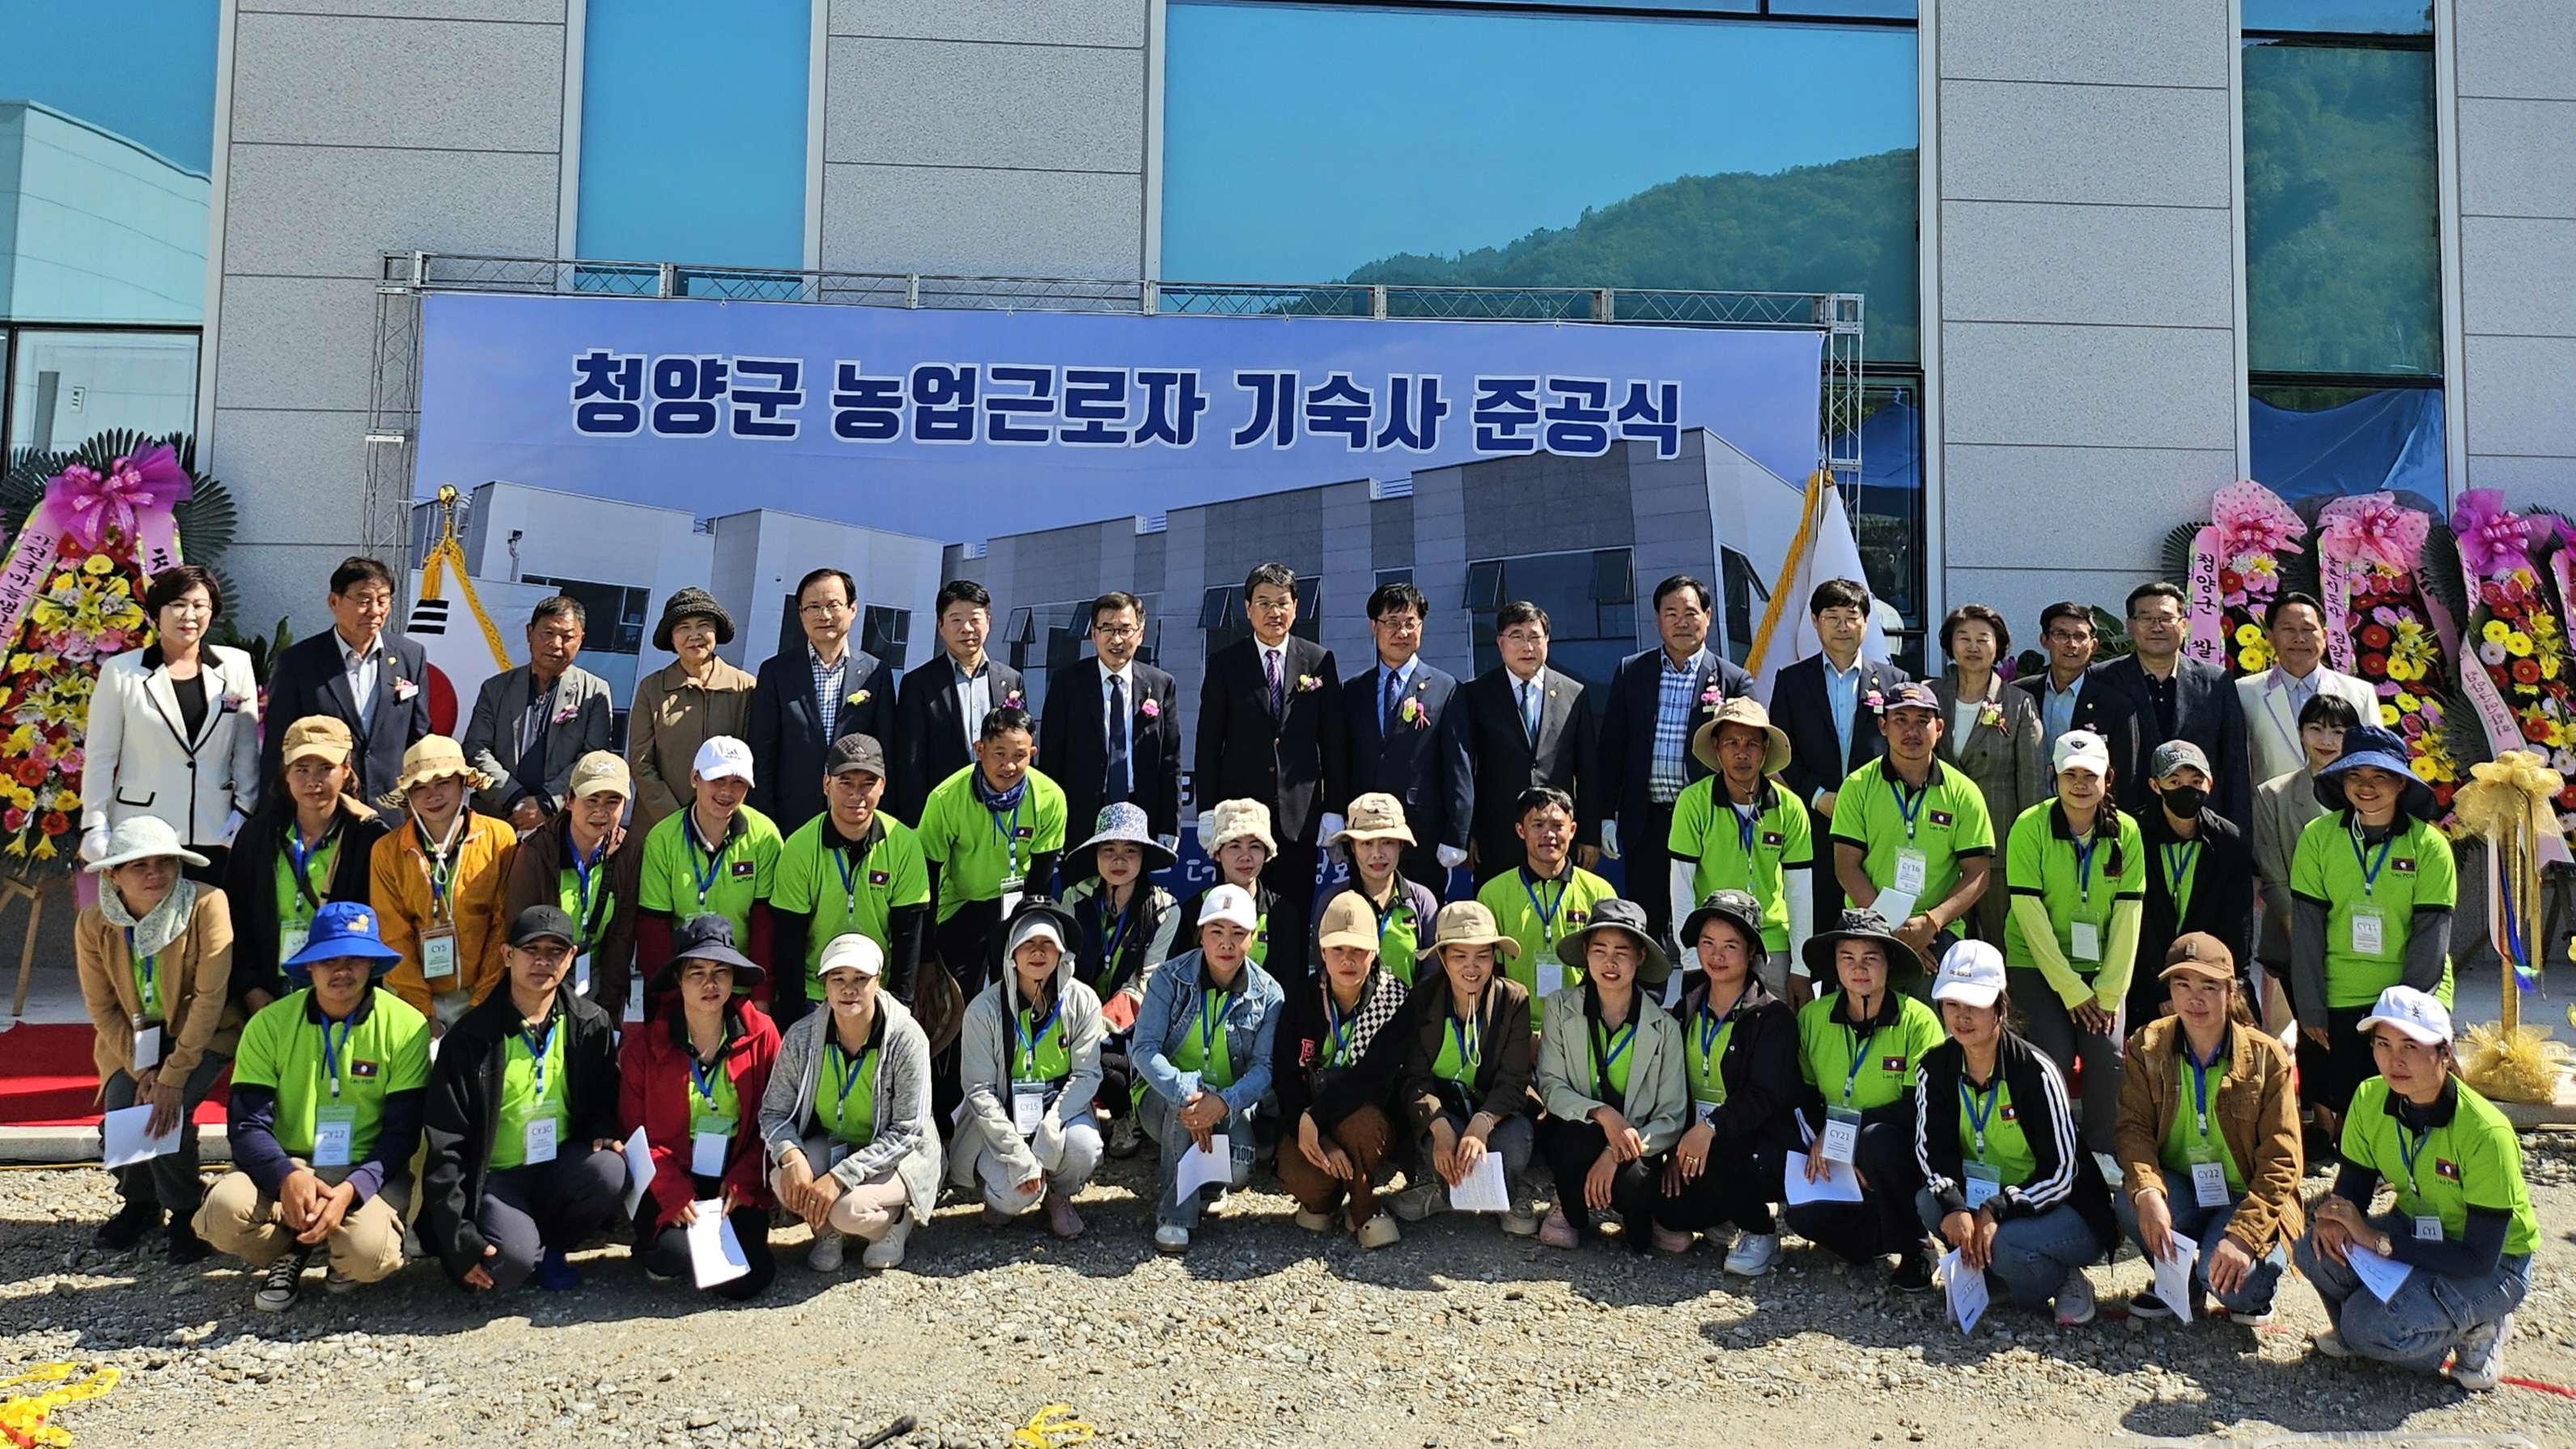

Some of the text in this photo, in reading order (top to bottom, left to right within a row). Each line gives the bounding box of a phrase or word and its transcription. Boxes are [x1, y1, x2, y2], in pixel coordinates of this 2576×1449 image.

[570, 348, 1683, 461] 청양군 농업근로자 기숙사 준공식
[2193, 553, 2217, 616] 청양군
[2328, 629, 2349, 672] 청양군
[1902, 862, 1920, 872] CY16
[431, 943, 447, 953] CY5
[1020, 1102, 1038, 1111] CY15
[323, 1130, 345, 1139] CY12
[532, 1125, 552, 1136] CY30
[1830, 1129, 1850, 1141] CY21
[2197, 1168, 2219, 1179] CY22
[2422, 1226, 2436, 1237] CY1
